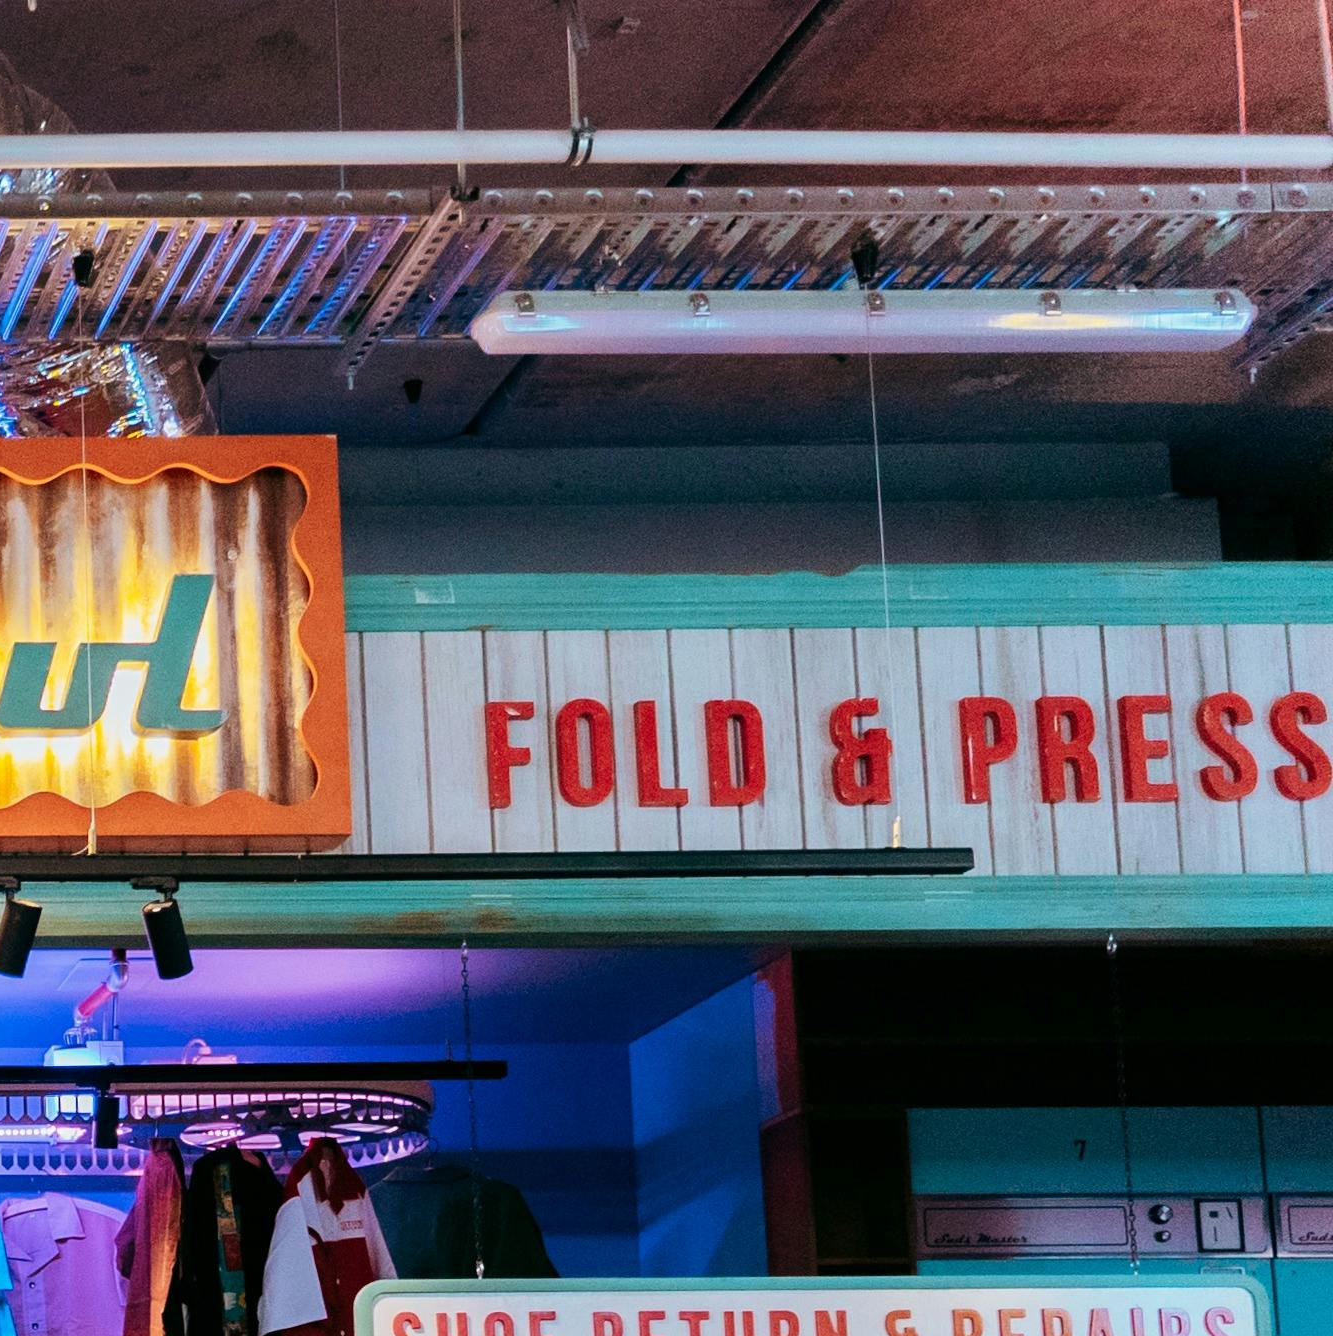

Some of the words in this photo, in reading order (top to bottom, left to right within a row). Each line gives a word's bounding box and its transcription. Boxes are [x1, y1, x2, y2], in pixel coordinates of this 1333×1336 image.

[483, 698, 767, 808] FOLD
[829, 697, 893, 807] &
[958, 691, 1333, 804] PRESS
[1073, 1139, 1087, 1161] 7
[933, 1232, 970, 1244] Suds
[974, 1232, 1029, 1244] Master
